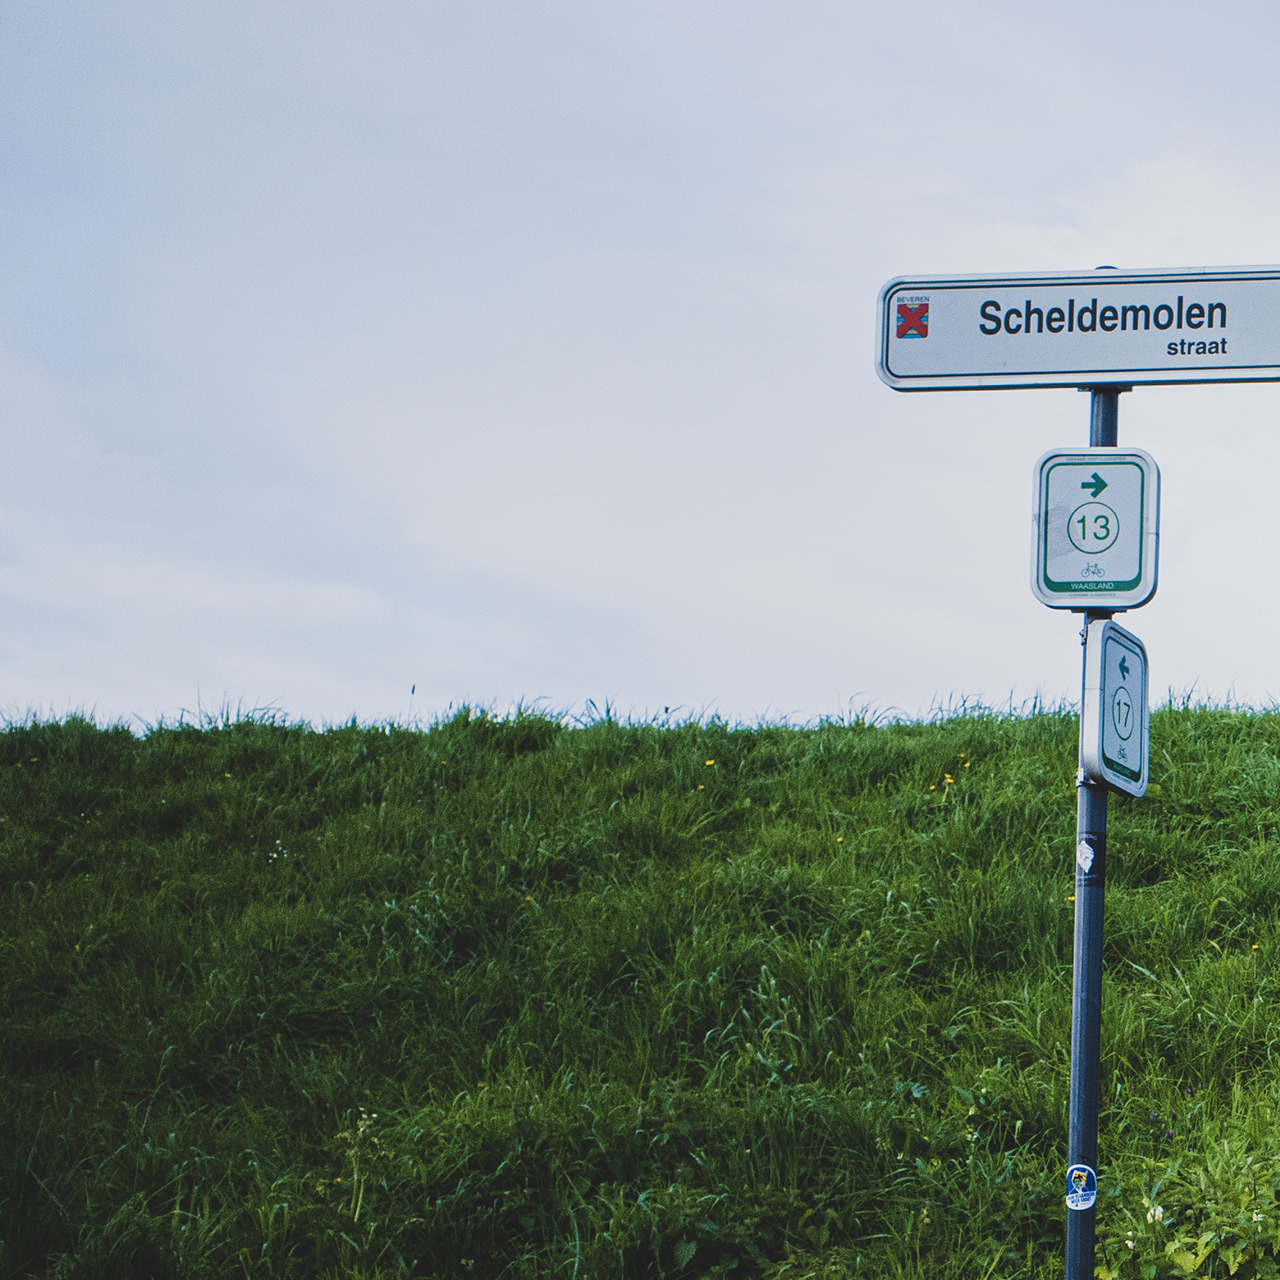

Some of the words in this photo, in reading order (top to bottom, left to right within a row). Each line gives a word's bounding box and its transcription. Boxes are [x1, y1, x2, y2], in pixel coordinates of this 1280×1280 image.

[979, 296, 1227, 335] Scheldemolen
[1166, 338, 1227, 356] straat
[1077, 515, 1110, 541] 13
[1071, 582, 1115, 590] WAASLAND
[1116, 700, 1131, 728] 17
